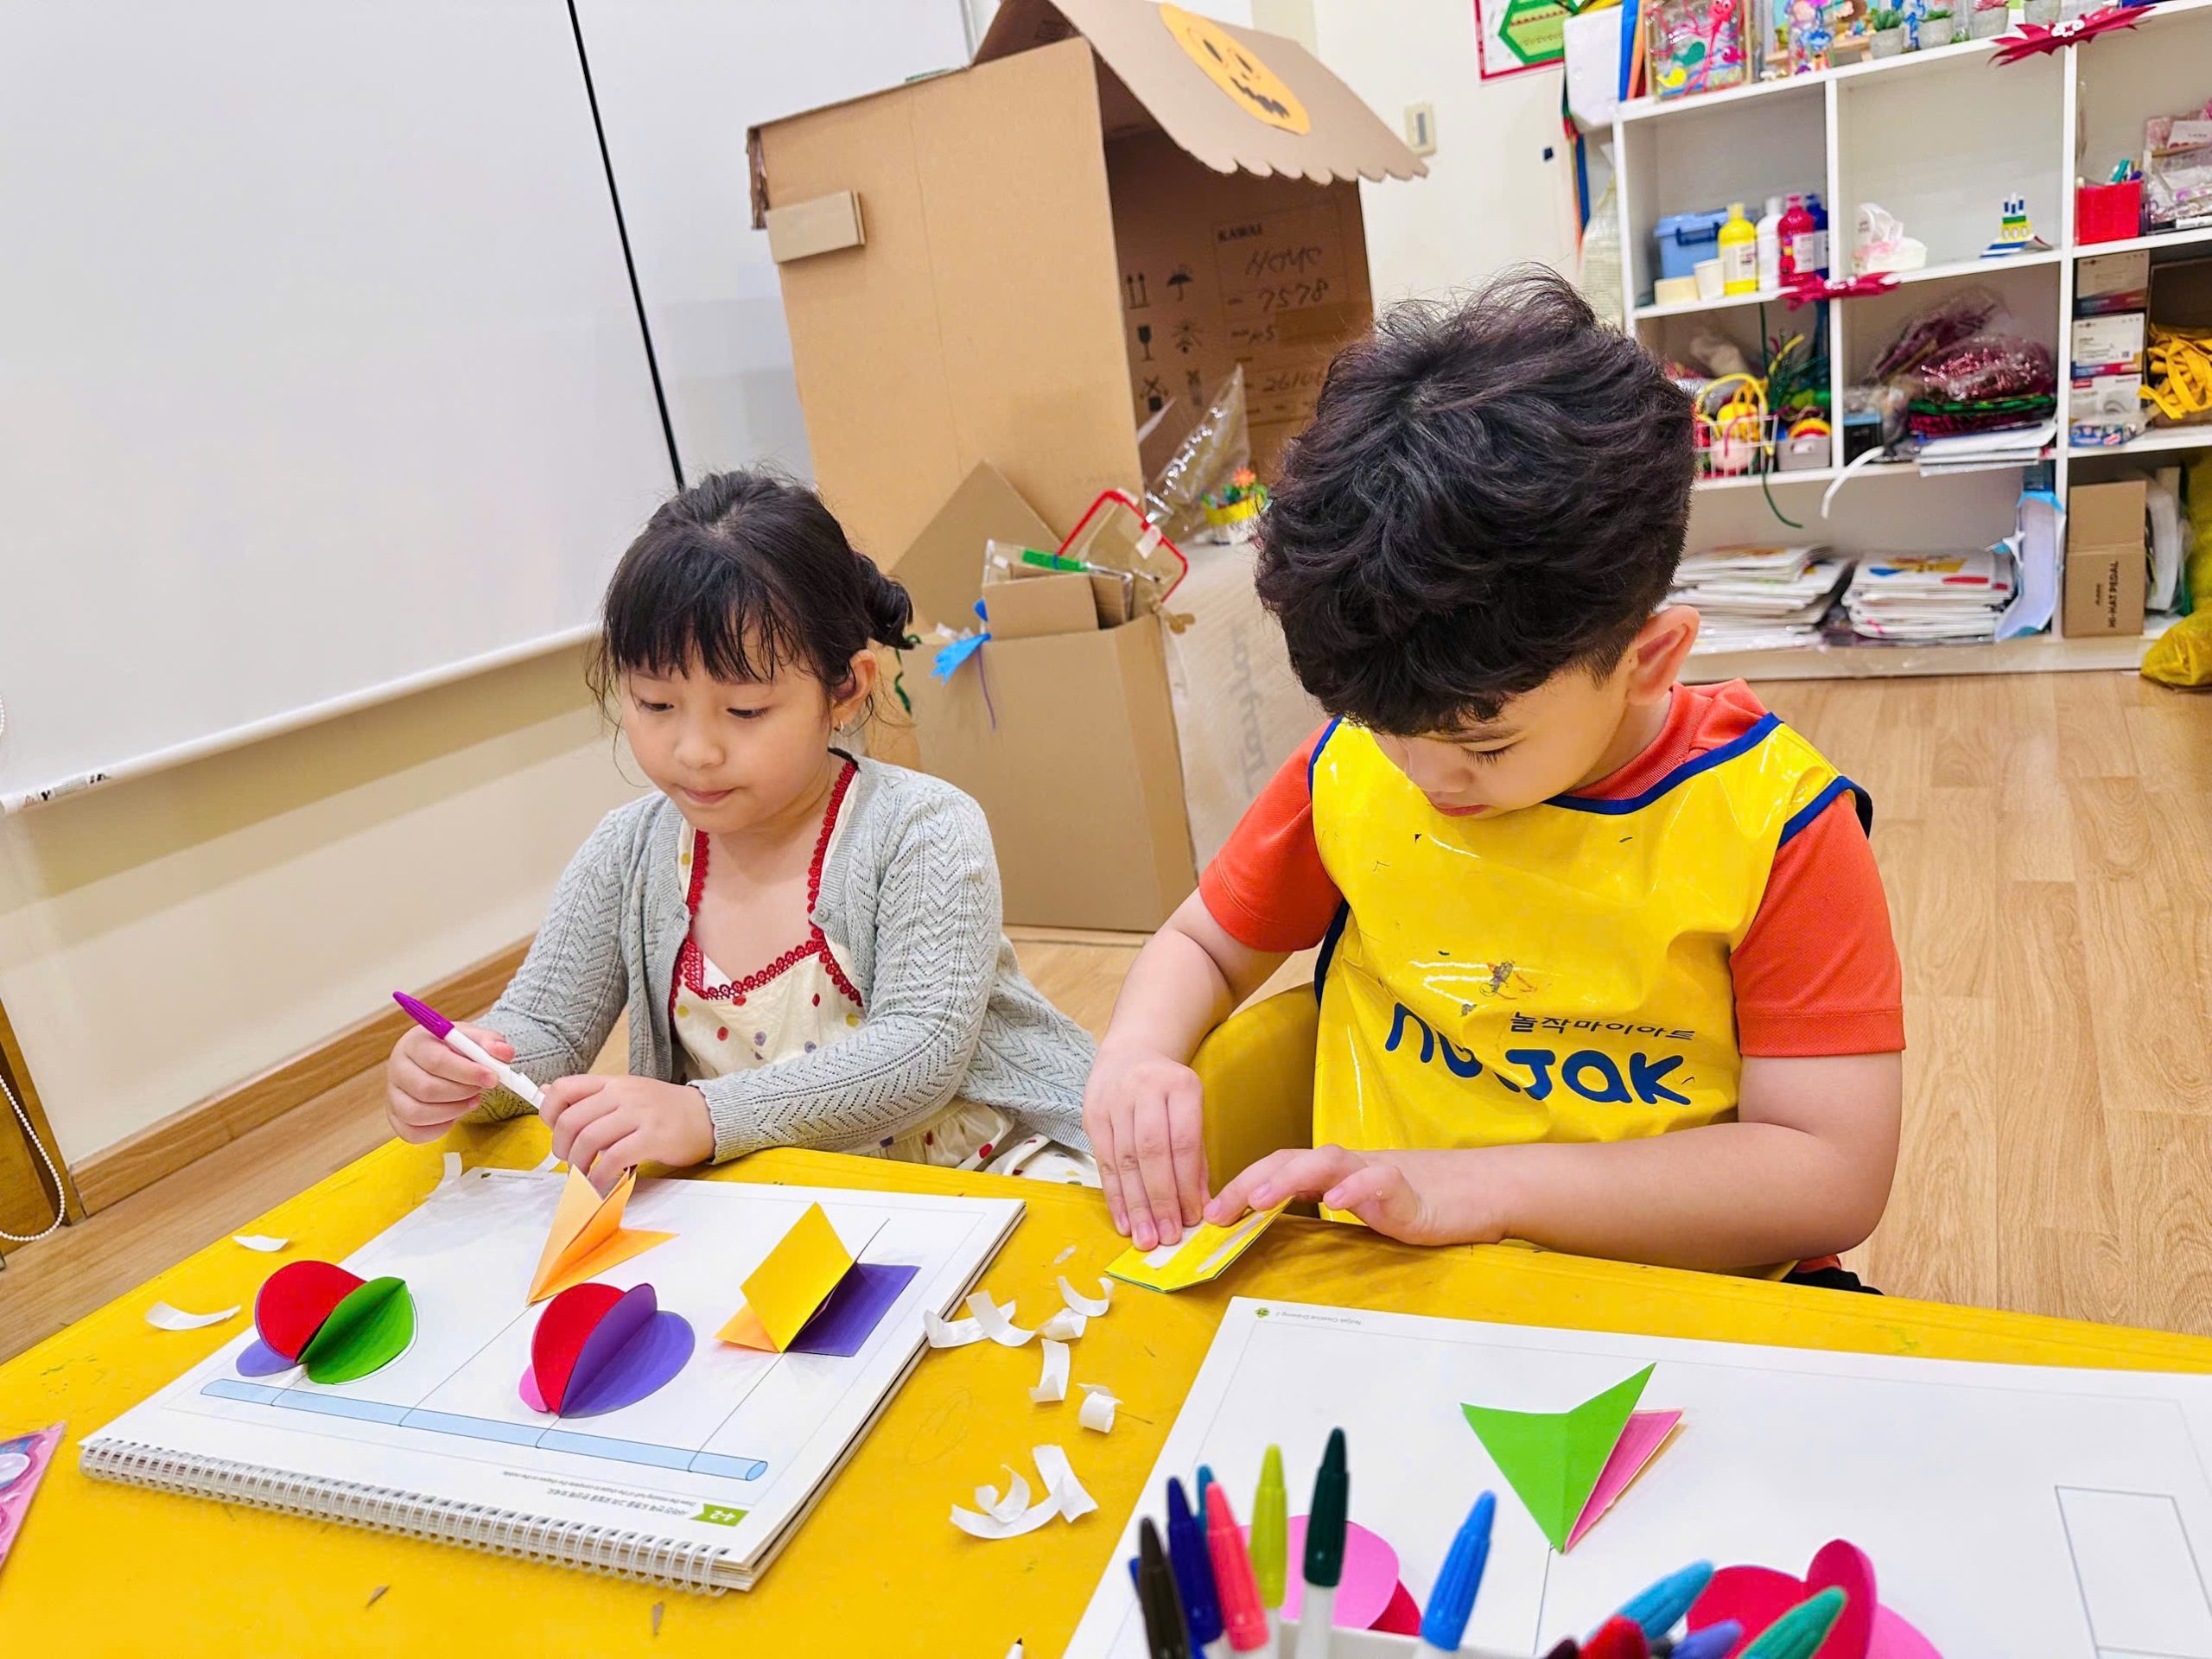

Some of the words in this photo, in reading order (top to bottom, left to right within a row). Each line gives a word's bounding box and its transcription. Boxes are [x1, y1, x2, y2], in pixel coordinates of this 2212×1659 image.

[2109, 560, 2119, 593] PEDAL
[1510, 1011, 1695, 1041] 놀작마이아트
[709, 1510, 737, 1522] 4-2
